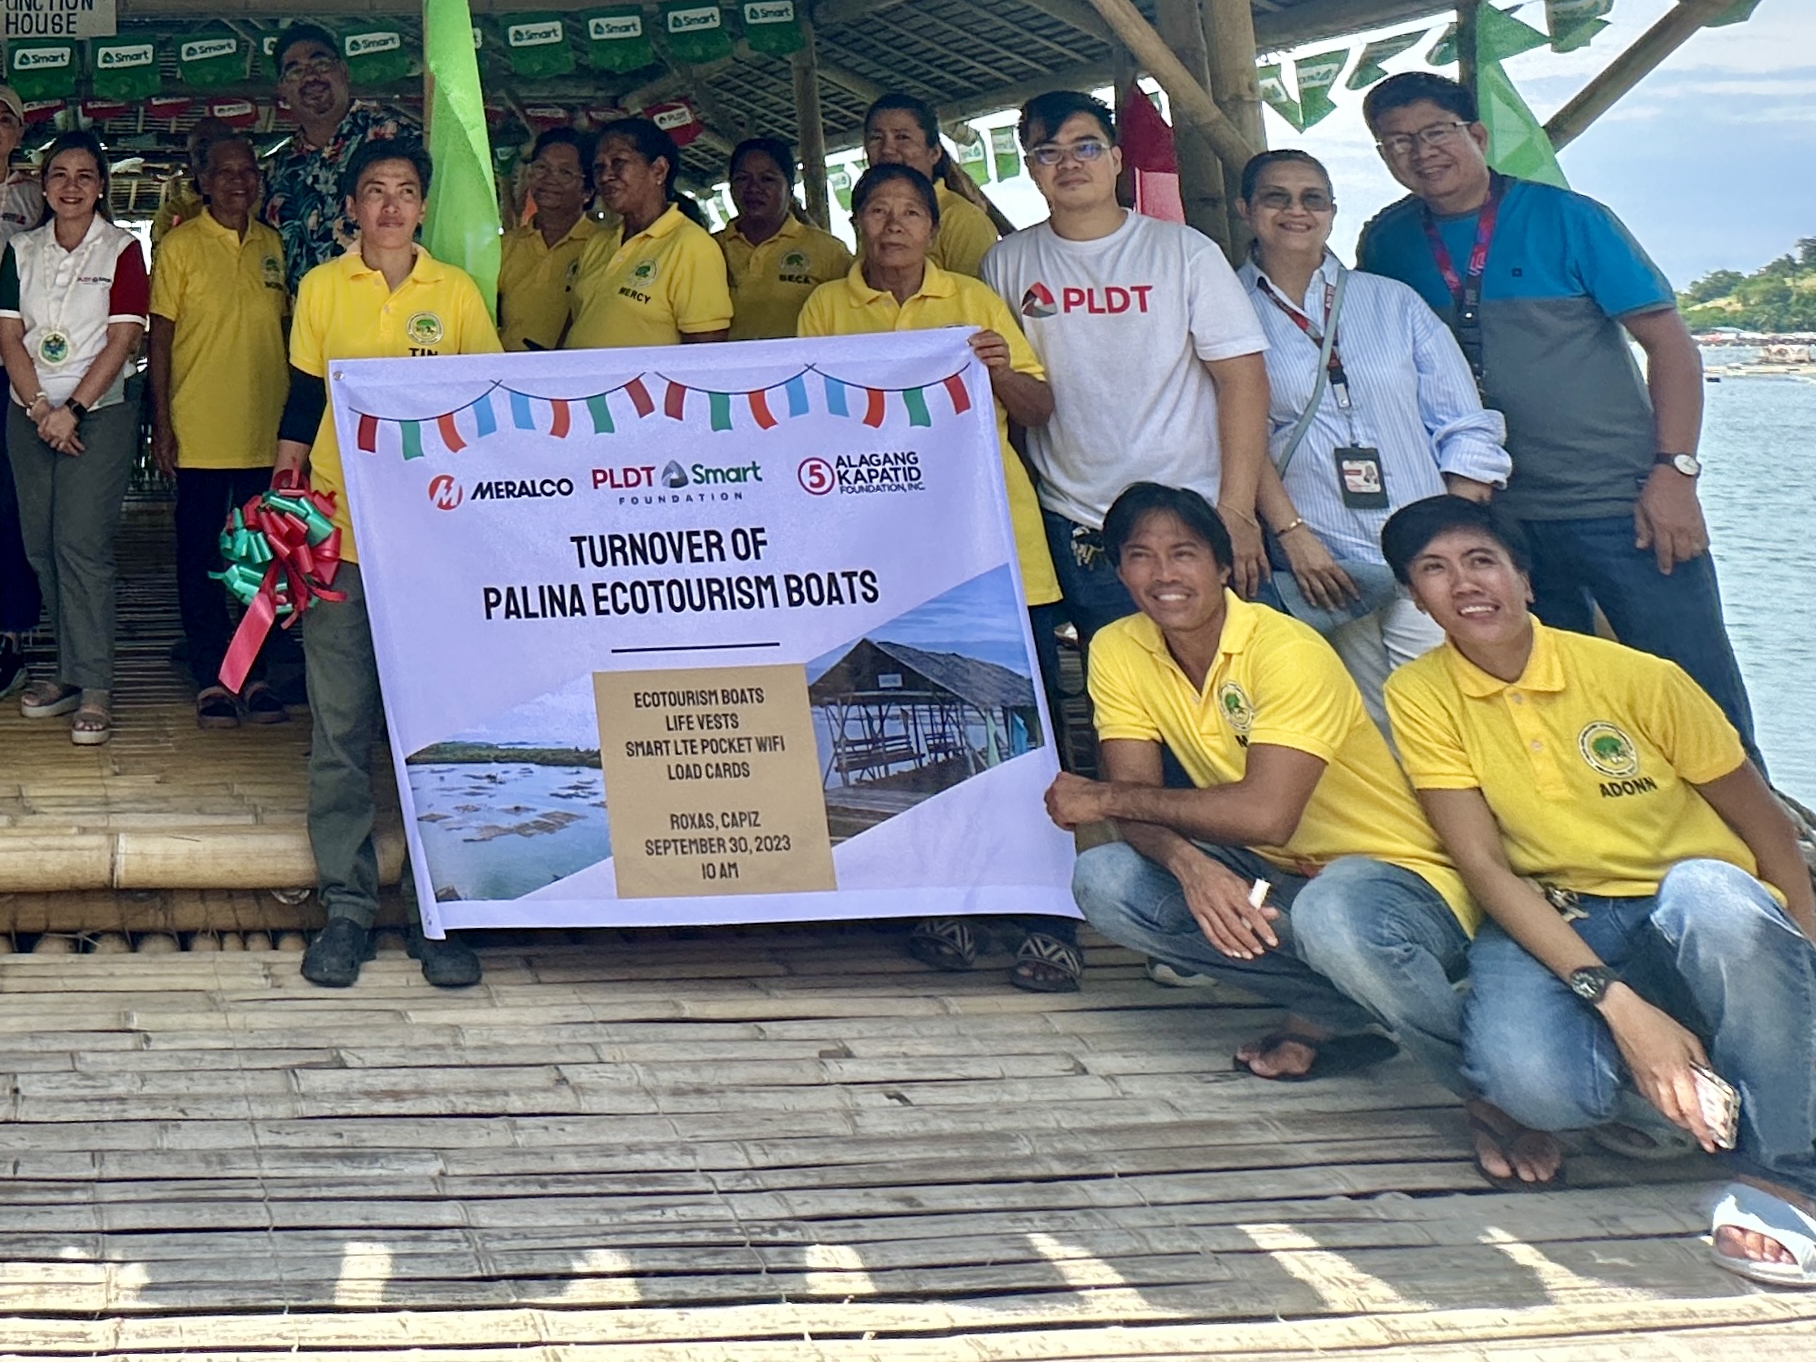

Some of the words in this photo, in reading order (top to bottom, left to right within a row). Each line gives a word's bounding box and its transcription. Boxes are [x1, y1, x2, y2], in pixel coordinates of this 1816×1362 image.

[5, 12, 77, 35] HOUSE
[683, 11, 717, 26] Smart
[525, 28, 559, 41] Smart
[114, 49, 150, 64] Smart
[198, 41, 233, 55] Smart
[31, 52, 67, 65] Smart
[618, 286, 651, 305] MERCY
[1063, 285, 1153, 314] PLDT
[835, 451, 919, 469] ALAGANG
[591, 466, 657, 489] PLDT
[691, 460, 763, 484] Smart
[808, 464, 827, 488] 5
[836, 466, 922, 486] KAPATID
[470, 477, 574, 501] MERALCO
[618, 491, 744, 506] FOUNDATION
[571, 530, 726, 569] TURNOVER
[732, 527, 768, 562] OF
[483, 581, 589, 620] PALINA
[592, 574, 781, 617] ECOTOURISM
[784, 569, 880, 608] BOATS
[634, 689, 719, 709] ECOTOURISM
[721, 687, 765, 706] BOATS
[666, 714, 694, 731] LIFE
[695, 713, 740, 730] VESTS
[626, 739, 672, 757] SMART
[674, 738, 698, 756] LTE
[700, 737, 753, 756] POCKET
[755, 735, 786, 753] WIFI
[667, 763, 703, 780] LOAD
[705, 761, 751, 780] CARDS
[1599, 776, 1658, 798] ADONN
[670, 813, 718, 832] ROXAS,
[721, 811, 761, 829] CAPIZ
[645, 837, 727, 857] SEPTEMBER
[729, 836, 753, 855] 30,
[755, 834, 791, 853] 2023
[701, 862, 717, 879] 10
[719, 861, 739, 879] AM
